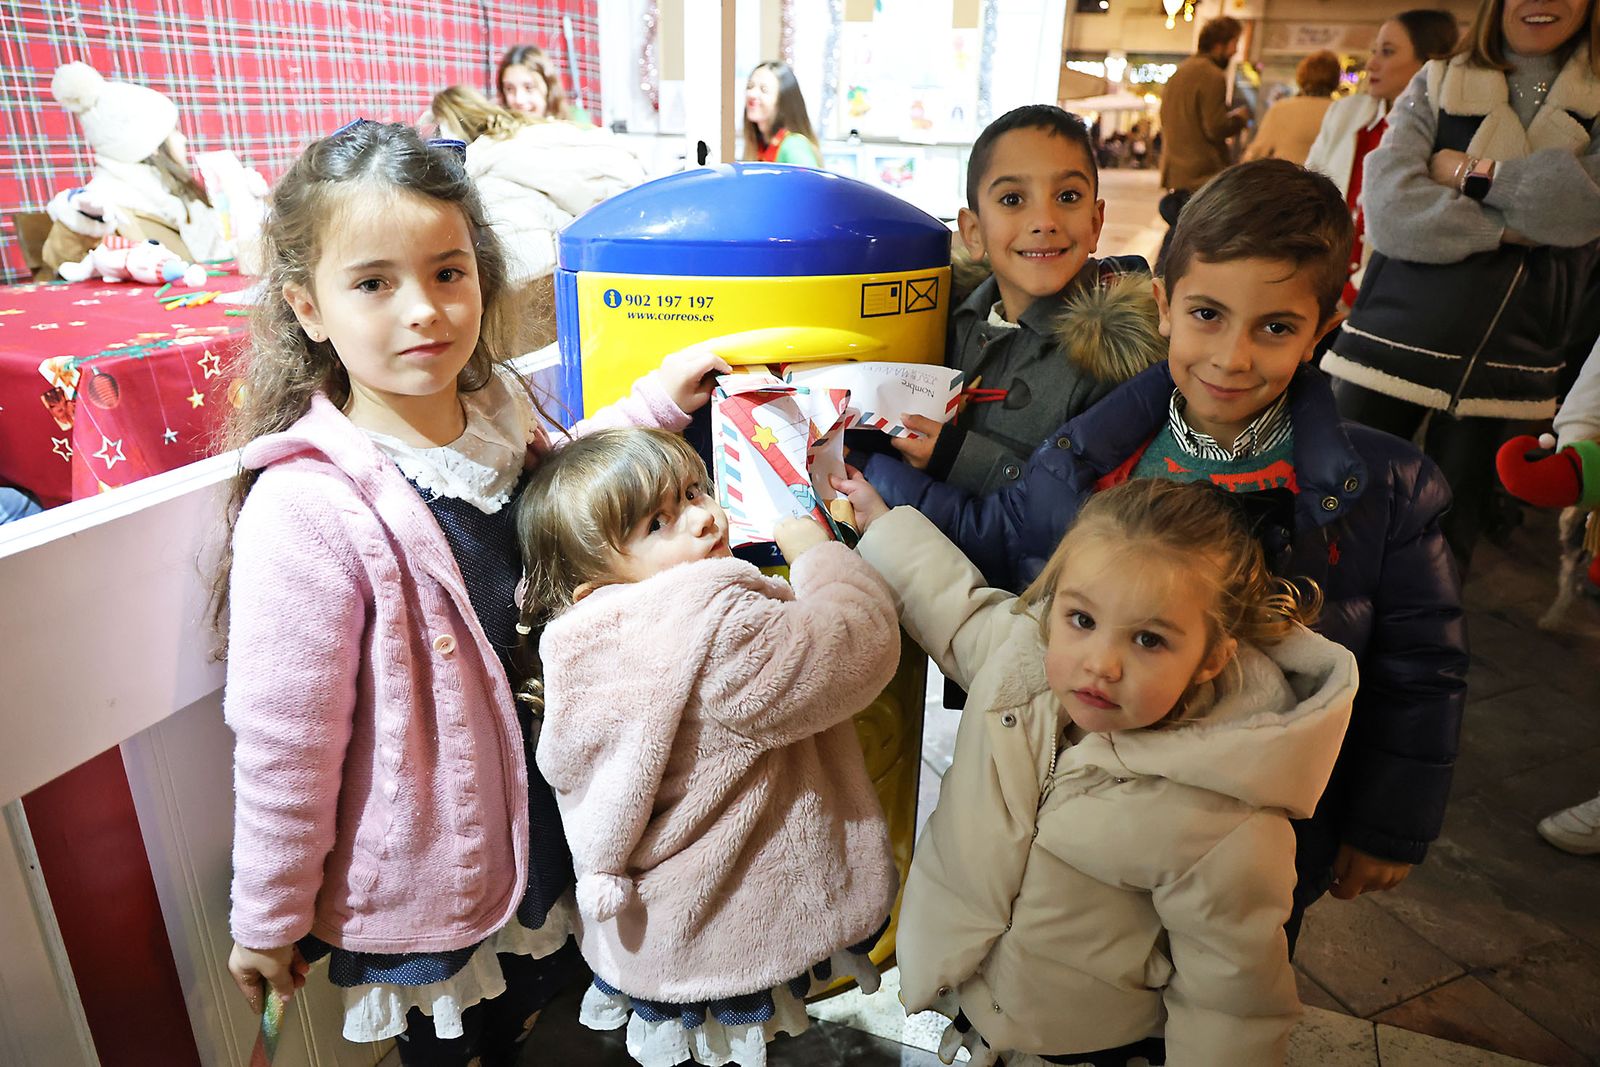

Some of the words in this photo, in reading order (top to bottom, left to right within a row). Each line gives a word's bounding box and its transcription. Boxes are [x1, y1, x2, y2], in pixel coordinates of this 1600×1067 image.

[625, 294, 651, 307] 902
[657, 295, 682, 308] 197
[688, 296, 714, 309] 197
[627, 311, 715, 322] www.correos.es
[901, 379, 934, 397] Nombre
